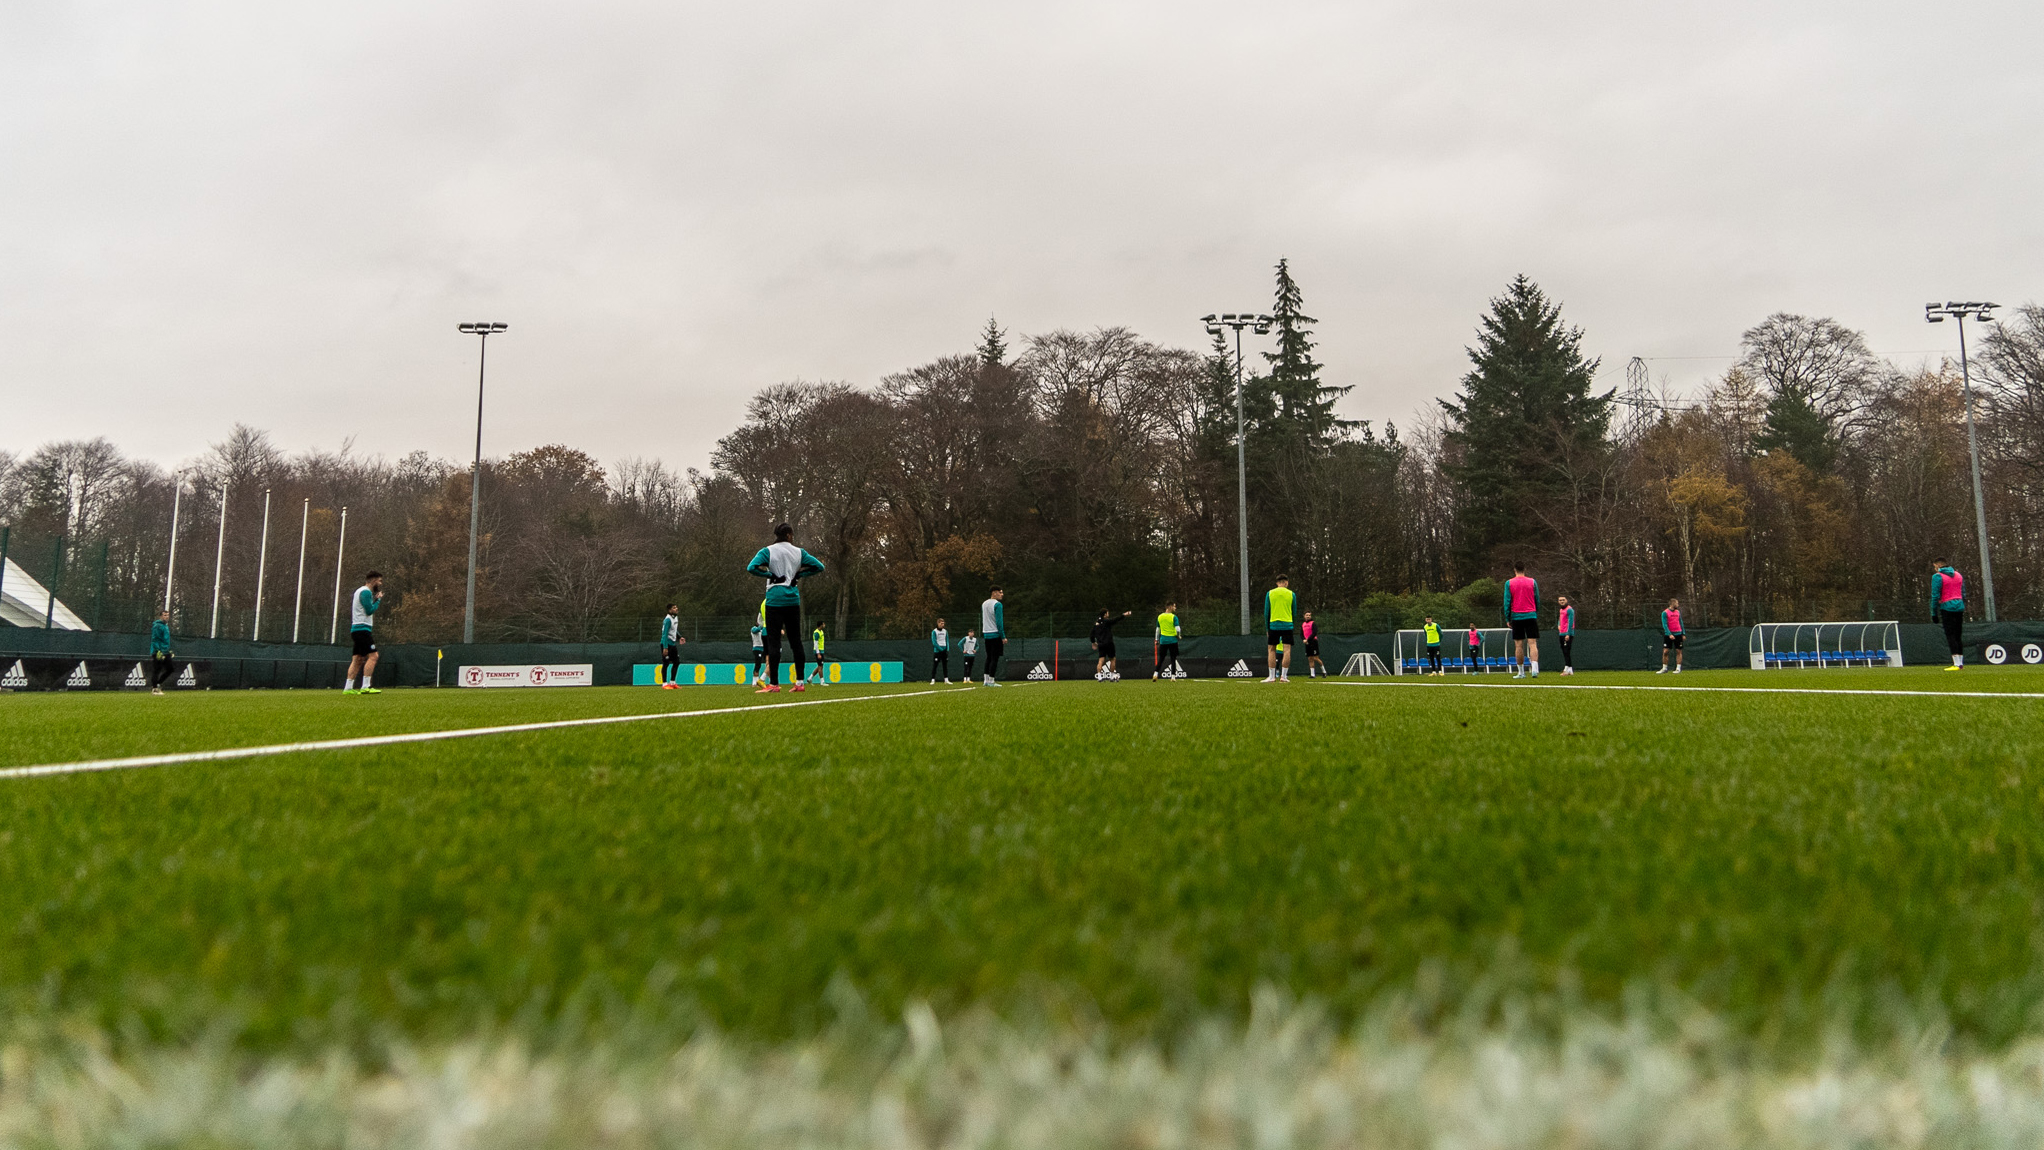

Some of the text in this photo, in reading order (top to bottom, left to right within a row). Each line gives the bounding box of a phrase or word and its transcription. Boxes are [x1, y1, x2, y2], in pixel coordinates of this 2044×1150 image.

[1989, 649, 2003, 659] JD
[2024, 649, 2039, 658] JD
[470, 672, 479, 681] T
[534, 671, 543, 681] T
[1027, 672, 1053, 680] adidas
[1161, 670, 1187, 678] addas
[1, 676, 28, 687] adidas
[67, 676, 91, 687] adidas
[125, 676, 146, 687] adidas
[177, 677, 196, 686] adidas
